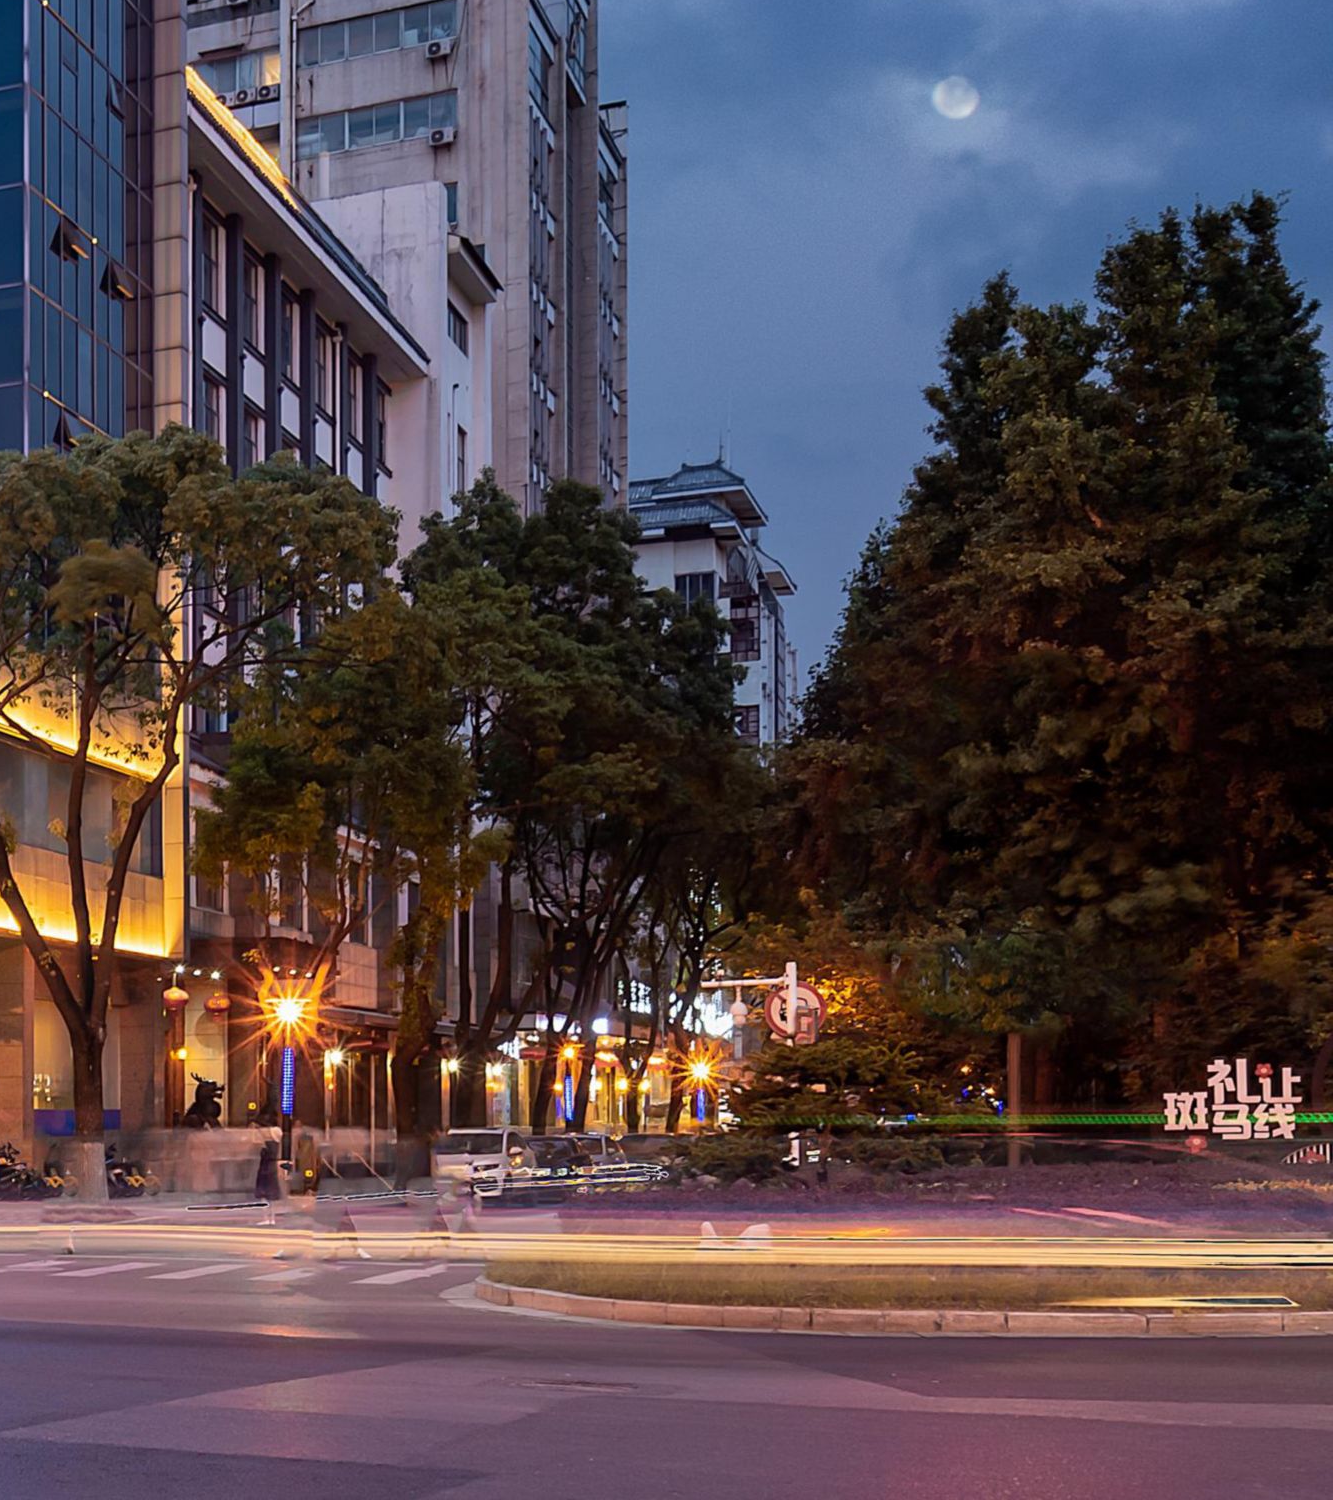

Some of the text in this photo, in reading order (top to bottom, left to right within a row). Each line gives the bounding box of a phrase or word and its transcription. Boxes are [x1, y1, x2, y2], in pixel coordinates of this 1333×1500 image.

[1206, 1057, 1303, 1104] 礼让
[1162, 1091, 1296, 1140] 斑马线
